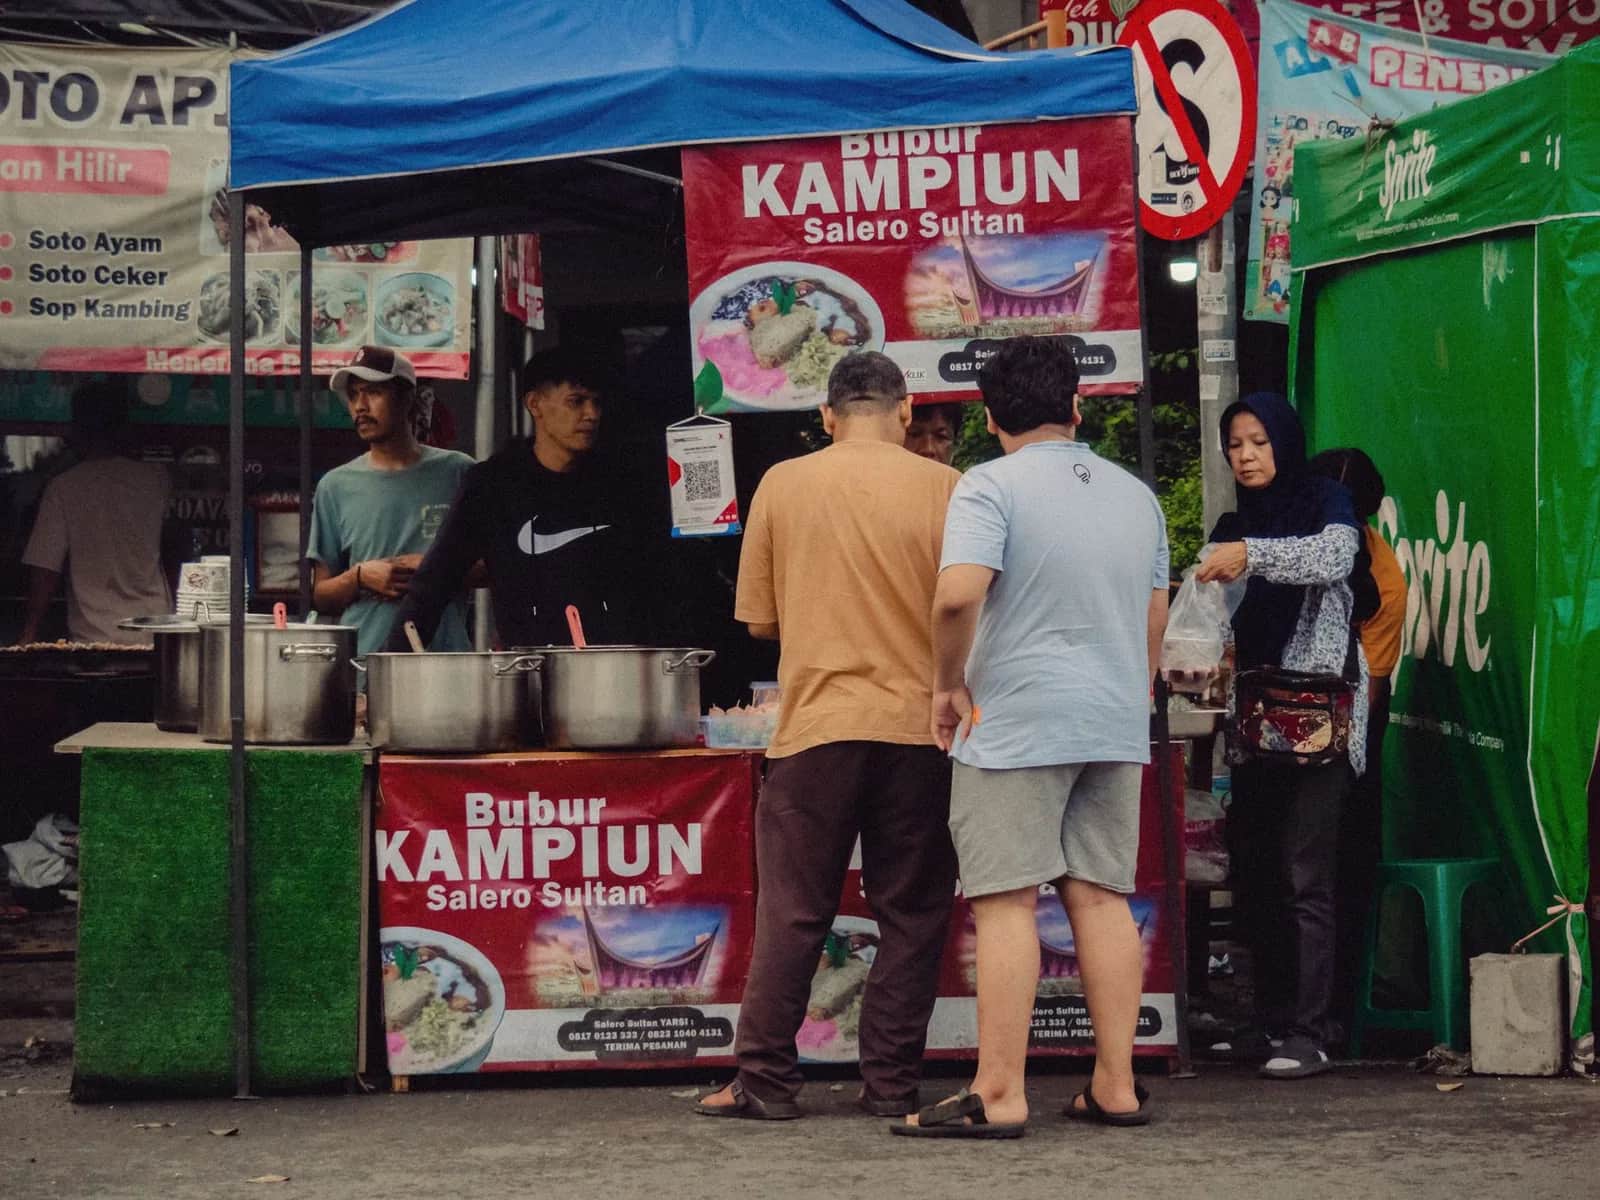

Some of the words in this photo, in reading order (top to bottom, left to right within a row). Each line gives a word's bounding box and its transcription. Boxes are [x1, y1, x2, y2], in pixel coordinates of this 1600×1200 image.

[1423, 0, 1450, 33] &
[0, 70, 100, 122] TO
[841, 127, 981, 159] Bubur
[57, 150, 133, 183] Hilir
[1379, 129, 1437, 222] Sprite
[742, 149, 1081, 218] KAMPIUN
[803, 215, 908, 244] Salero
[919, 209, 1025, 238] Sultan
[29, 231, 86, 250] Soto
[94, 232, 162, 255] Ayam
[29, 264, 86, 283] Soto
[94, 265, 168, 285] Ceker
[29, 297, 77, 320] Sop
[85, 299, 191, 321] Kambing
[1080, 355, 1106, 365] 4131
[465, 792, 606, 828] Bubur
[376, 823, 703, 882] KAMPIUN
[426, 884, 531, 912] Salero
[541, 881, 647, 908] Sultan
[594, 1021, 625, 1029] Salero
[628, 1019, 658, 1028] Sultan
[661, 1018, 688, 1026] YARSI
[1056, 1007, 1086, 1015] Sultan
[569, 1032, 592, 1041] 0817
[594, 1031, 618, 1040] 0123
[673, 1029, 697, 1038] 1040
[698, 1028, 723, 1037] 4131
[605, 1042, 640, 1051] TERIMA
[1033, 1029, 1068, 1038] TERIMA
